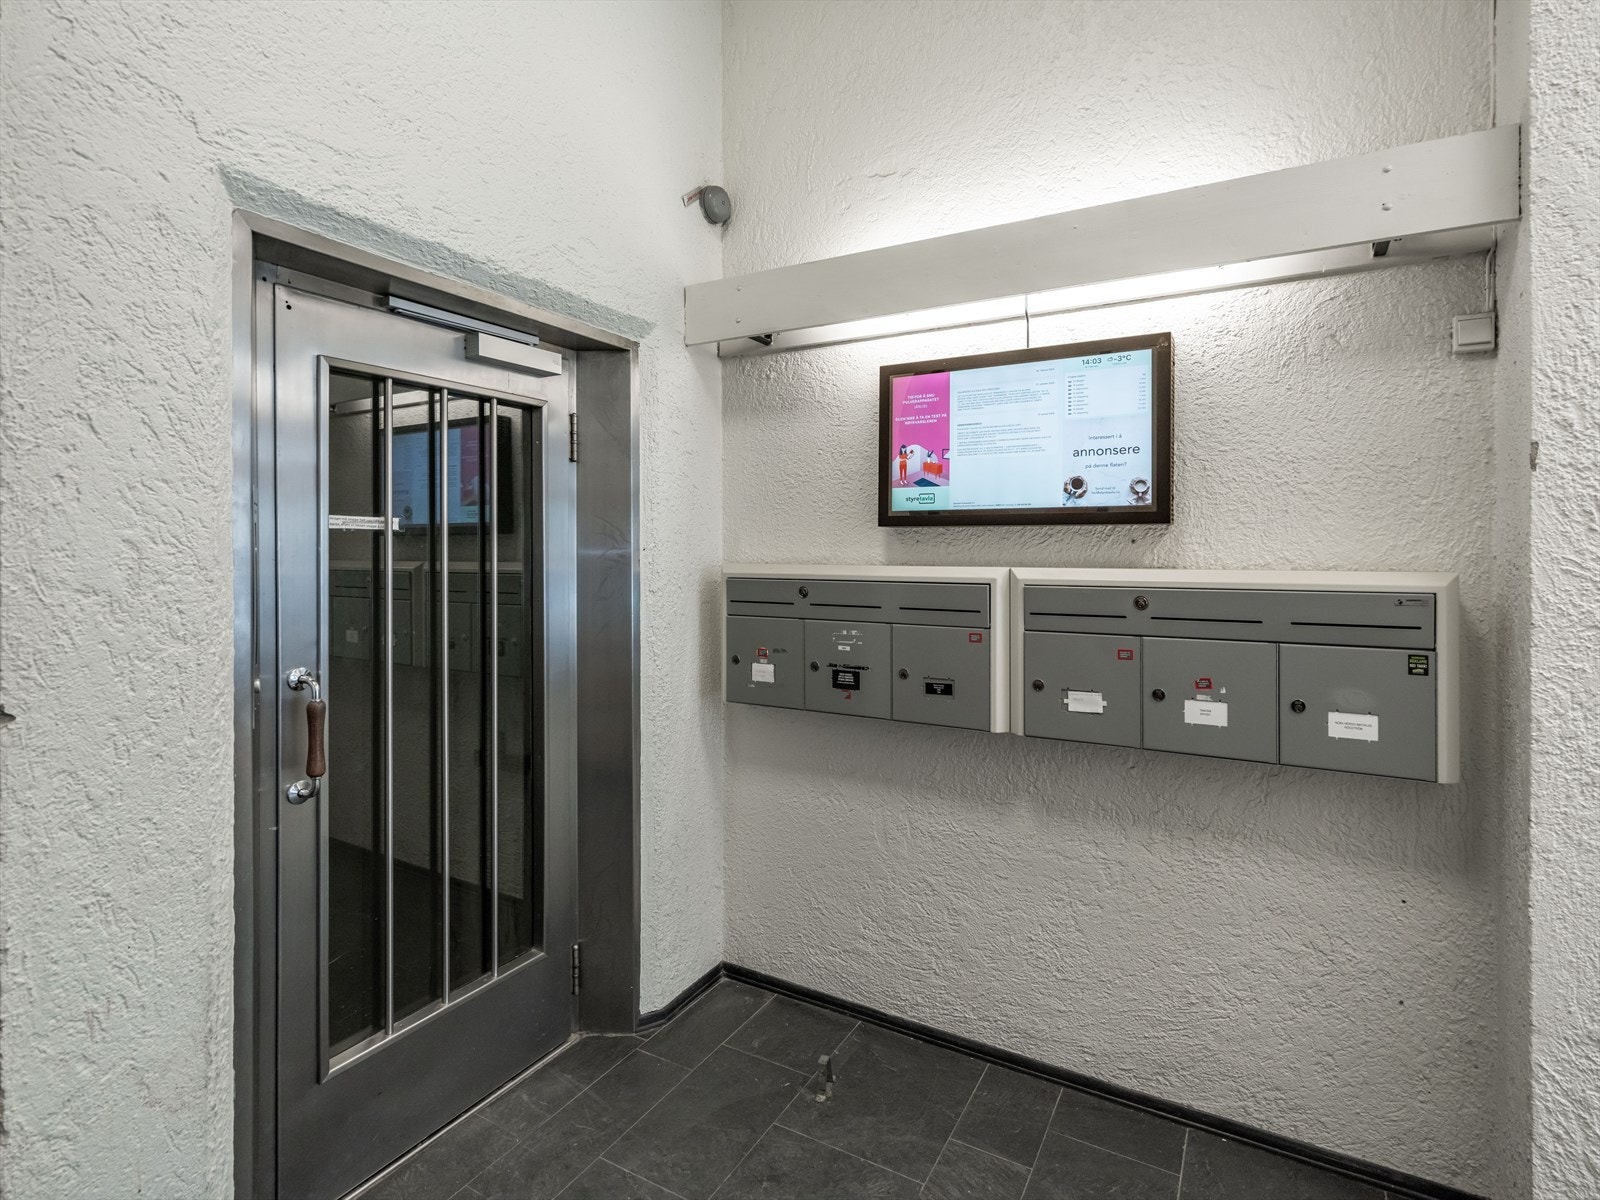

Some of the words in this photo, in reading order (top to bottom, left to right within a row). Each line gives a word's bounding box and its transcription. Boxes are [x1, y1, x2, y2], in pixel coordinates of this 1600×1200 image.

[1082, 358, 1102, 366] 14:03
[1114, 354, 1132, 362] -3°C
[1072, 446, 1140, 457] annonsere
[906, 495, 933, 503] styretavla
